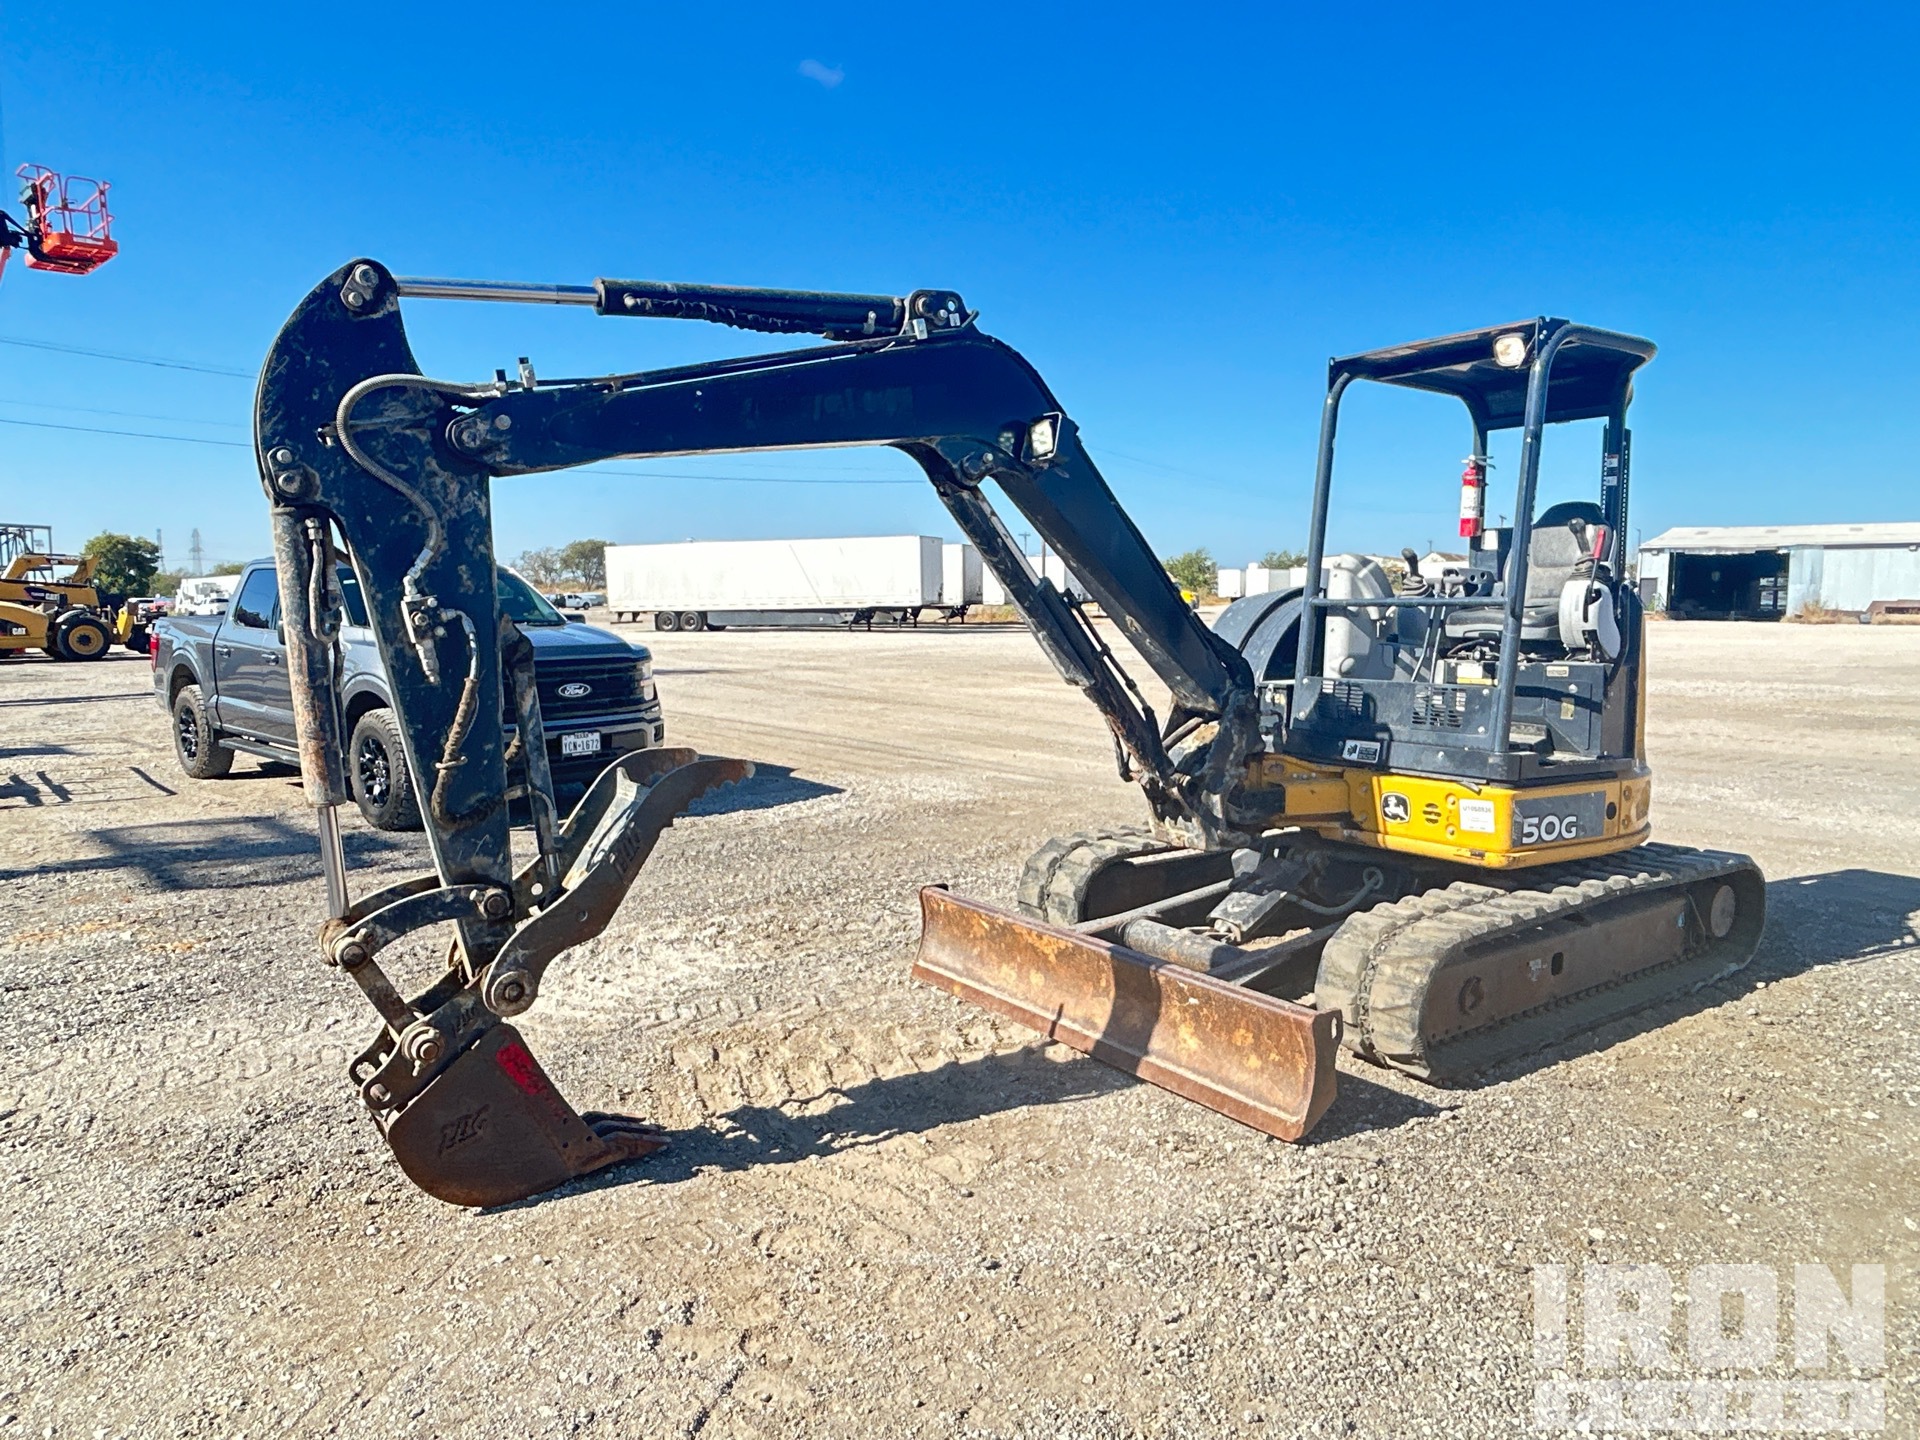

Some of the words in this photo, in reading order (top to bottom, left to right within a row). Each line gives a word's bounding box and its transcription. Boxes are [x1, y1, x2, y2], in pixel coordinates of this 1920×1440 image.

[12, 627, 26, 635] CAT
[564, 685, 585, 695] Ford
[1522, 815, 1577, 844] 50G
